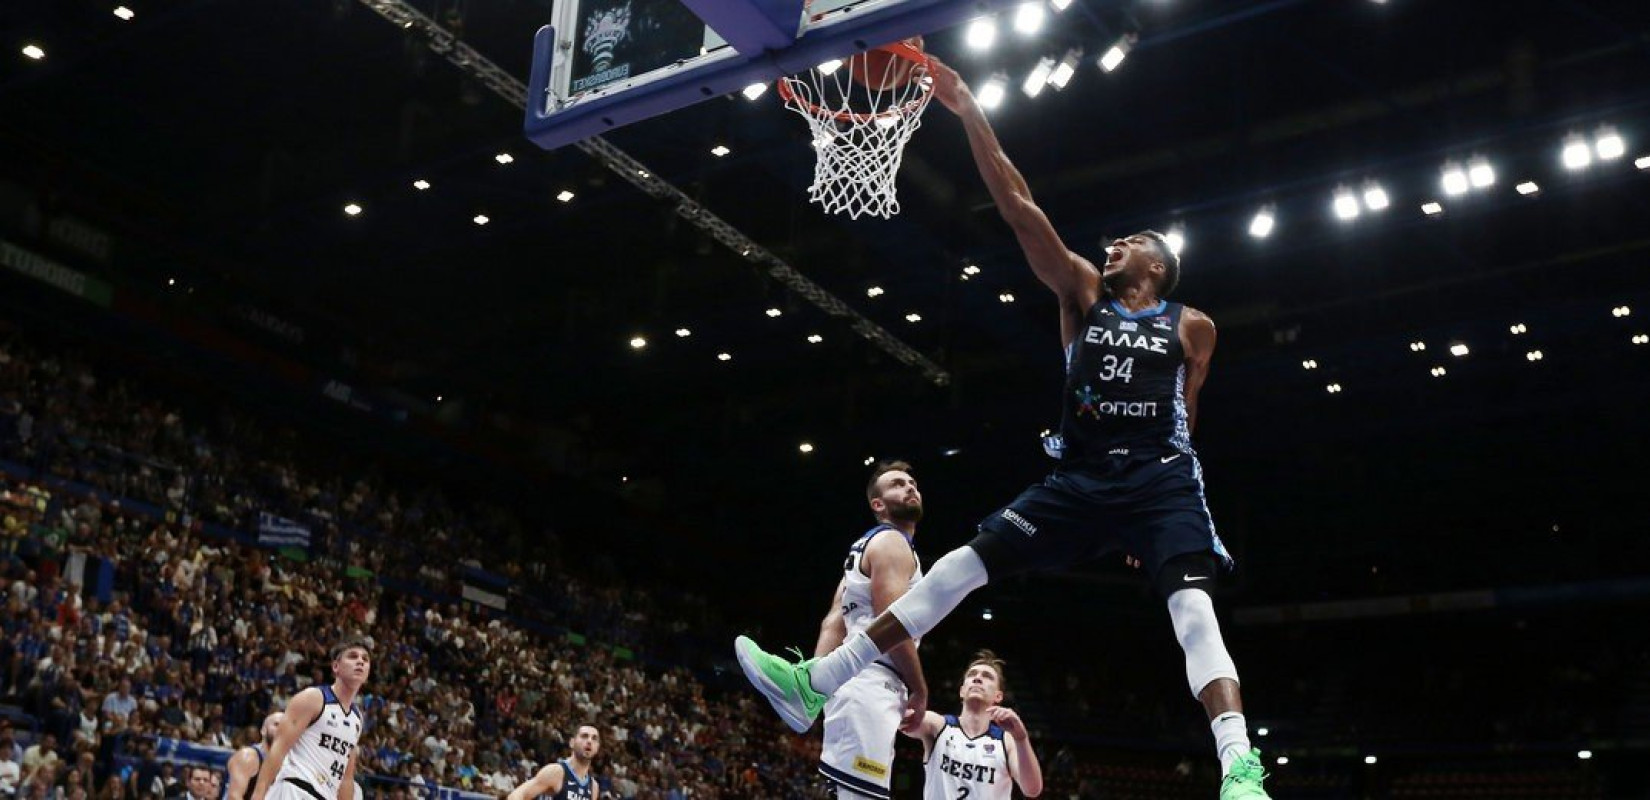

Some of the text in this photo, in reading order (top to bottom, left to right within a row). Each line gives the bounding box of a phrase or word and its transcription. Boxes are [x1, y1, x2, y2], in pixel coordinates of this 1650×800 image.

[1084, 325, 1169, 355] ΕΛΛΑΣ
[1099, 353, 1135, 384] 34
[330, 760, 344, 781] 44
[940, 753, 996, 784] EESTI
